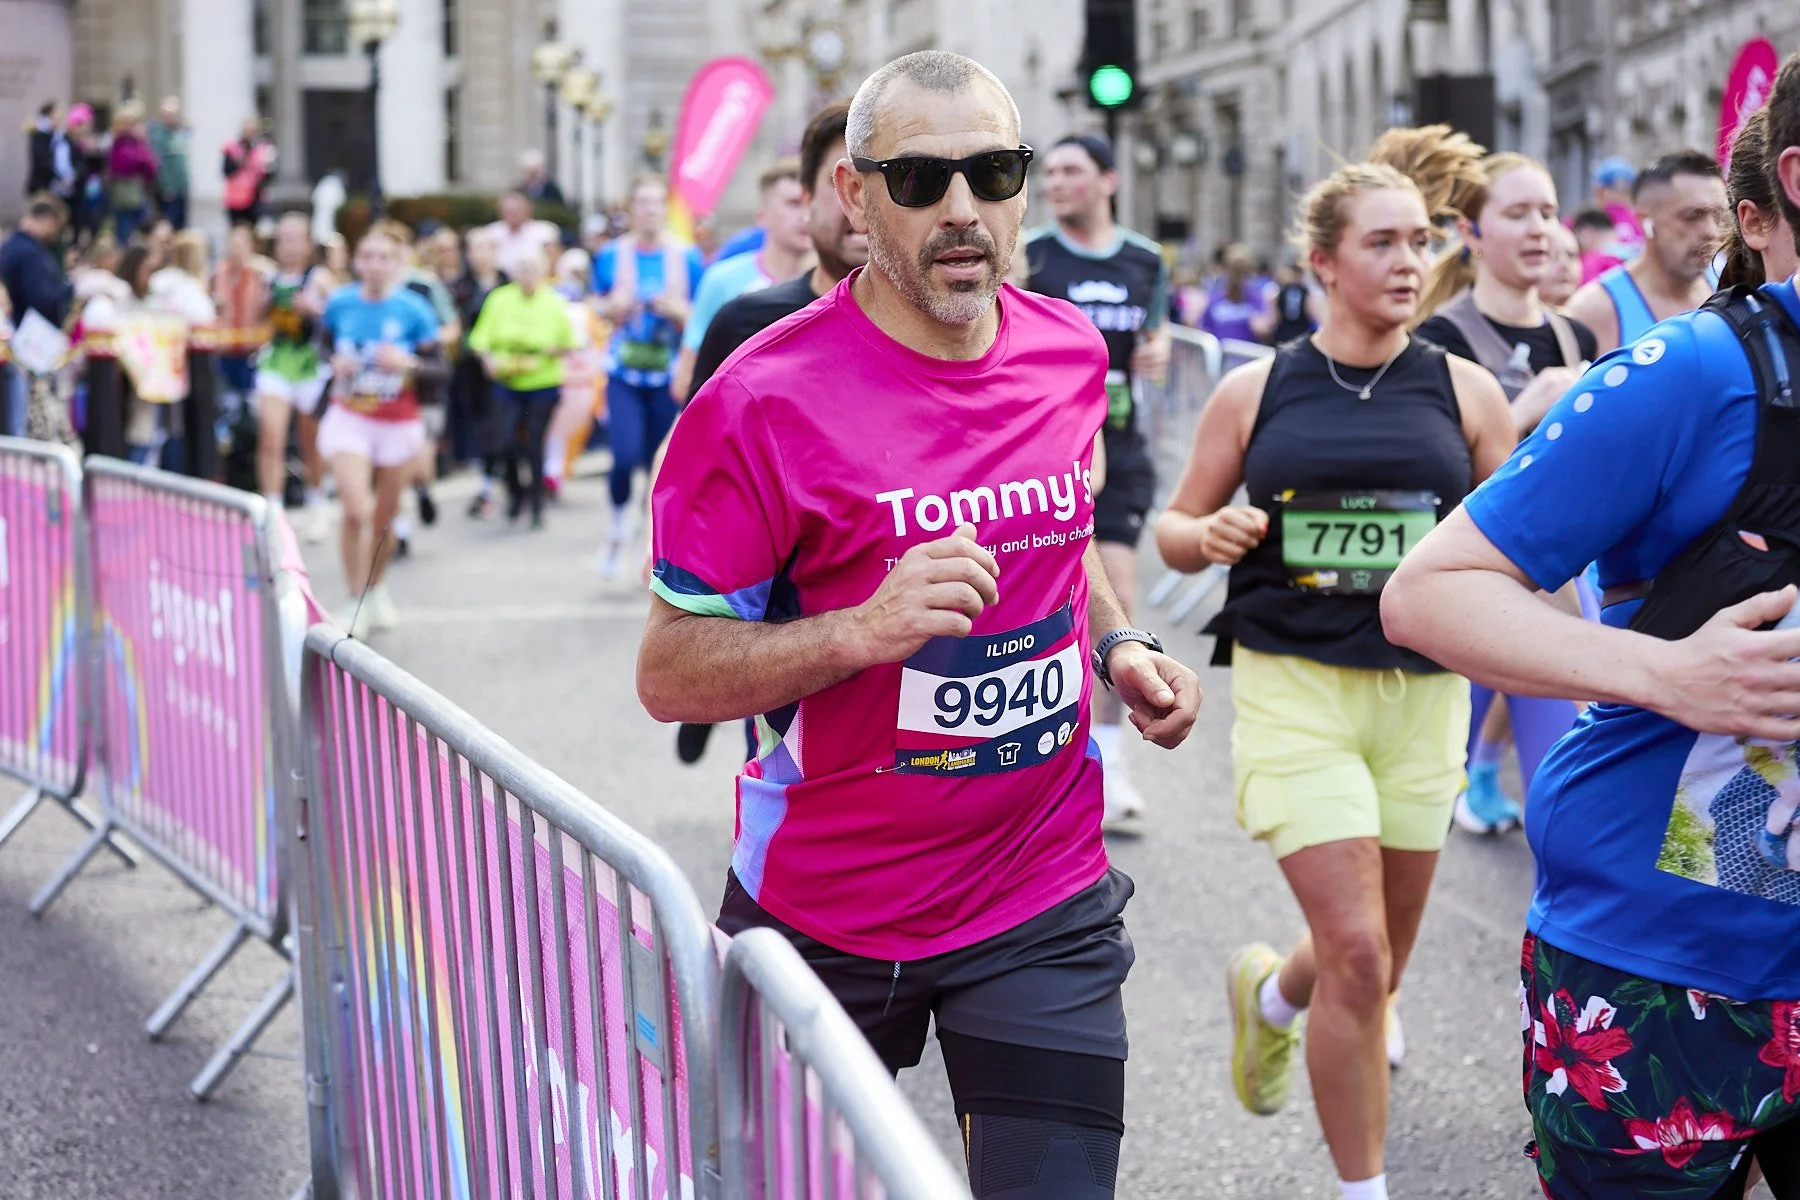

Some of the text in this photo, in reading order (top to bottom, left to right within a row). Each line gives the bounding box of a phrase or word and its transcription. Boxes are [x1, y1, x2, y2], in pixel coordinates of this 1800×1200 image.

[875, 460, 1092, 537] Tommy's
[1341, 495, 1377, 509] LUCY
[1001, 535, 1029, 553] and
[1033, 530, 1066, 548] baby
[1307, 522, 1405, 556] 7791
[986, 634, 1035, 658] ILIDIO
[933, 659, 1064, 729] 9940
[911, 755, 940, 766] LONDON
